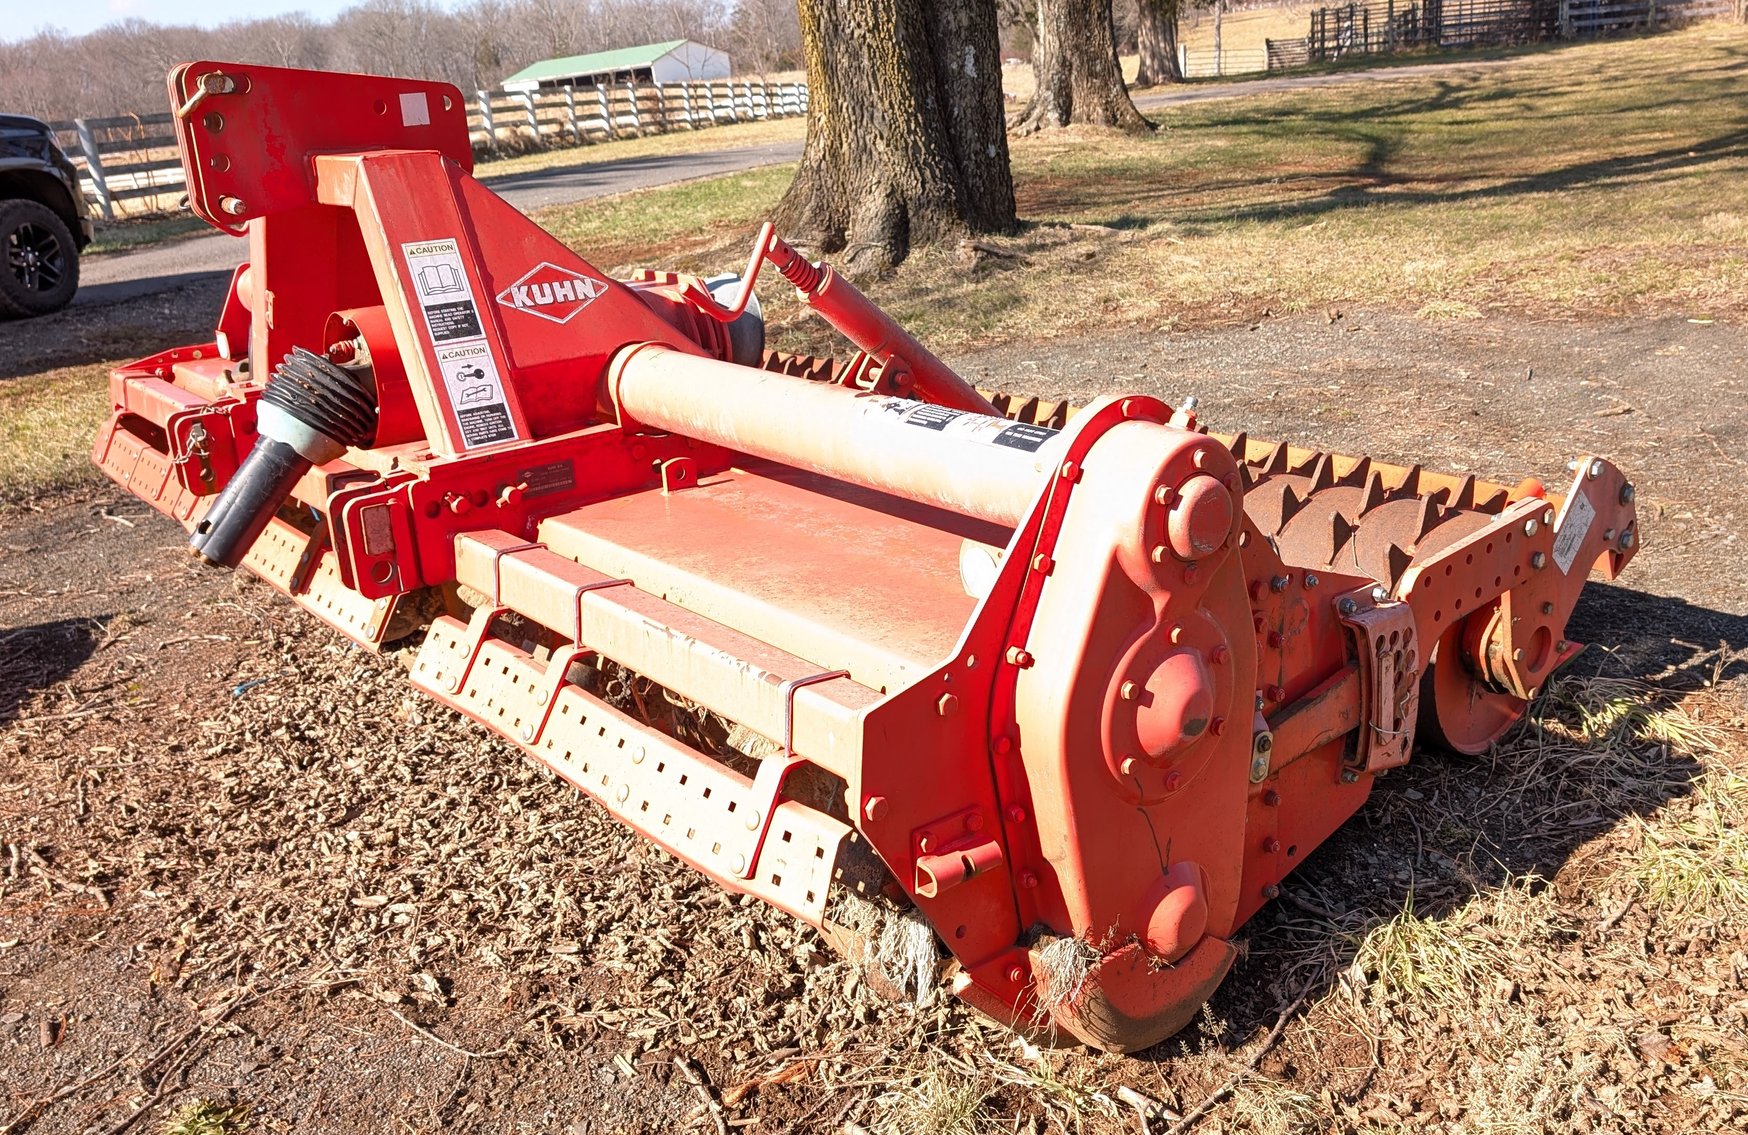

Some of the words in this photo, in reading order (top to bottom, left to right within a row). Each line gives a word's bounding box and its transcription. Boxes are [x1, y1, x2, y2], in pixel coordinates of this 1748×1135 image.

[416, 244, 453, 254] CAUTION
[510, 278, 596, 308] KUHN
[448, 347, 485, 358] CAUTION
